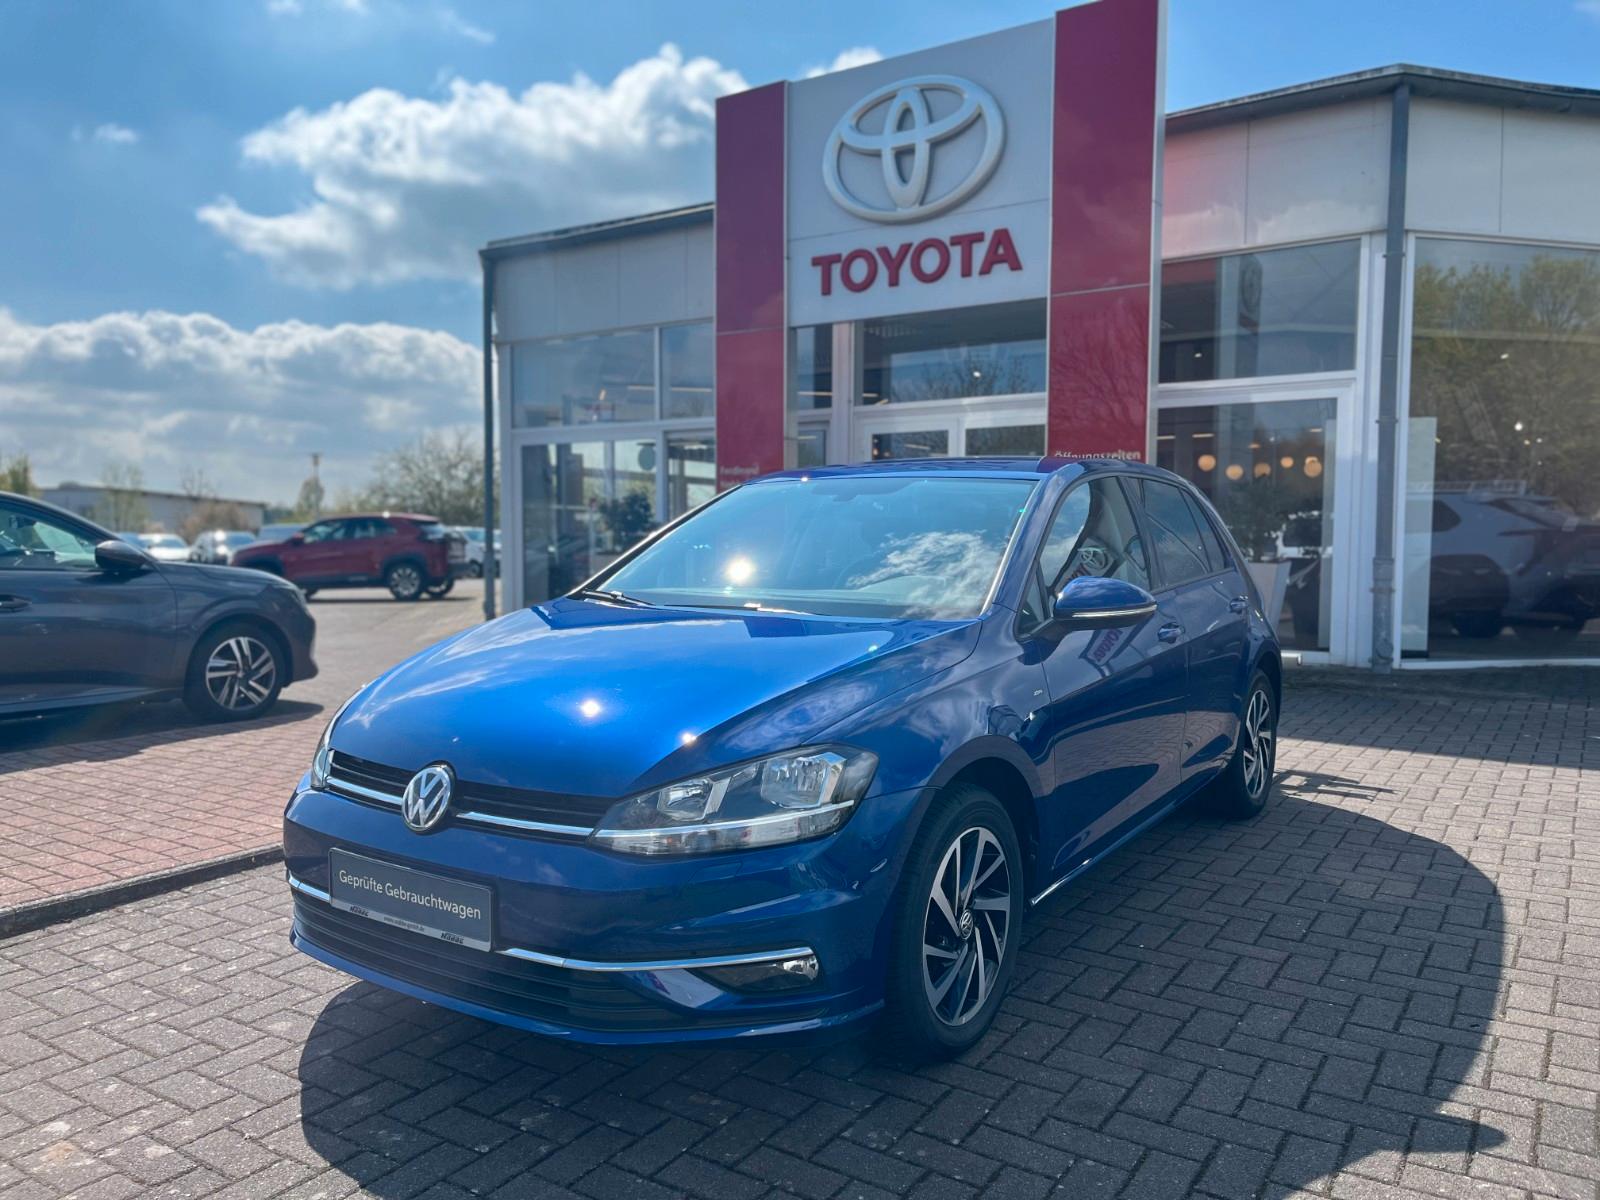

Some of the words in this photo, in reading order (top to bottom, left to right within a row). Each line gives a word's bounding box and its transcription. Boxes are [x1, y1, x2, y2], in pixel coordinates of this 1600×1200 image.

[811, 228, 1023, 296] TOYOTA
[339, 869, 383, 894] Geprüfte
[385, 882, 481, 920] Gebrauchtwagen
